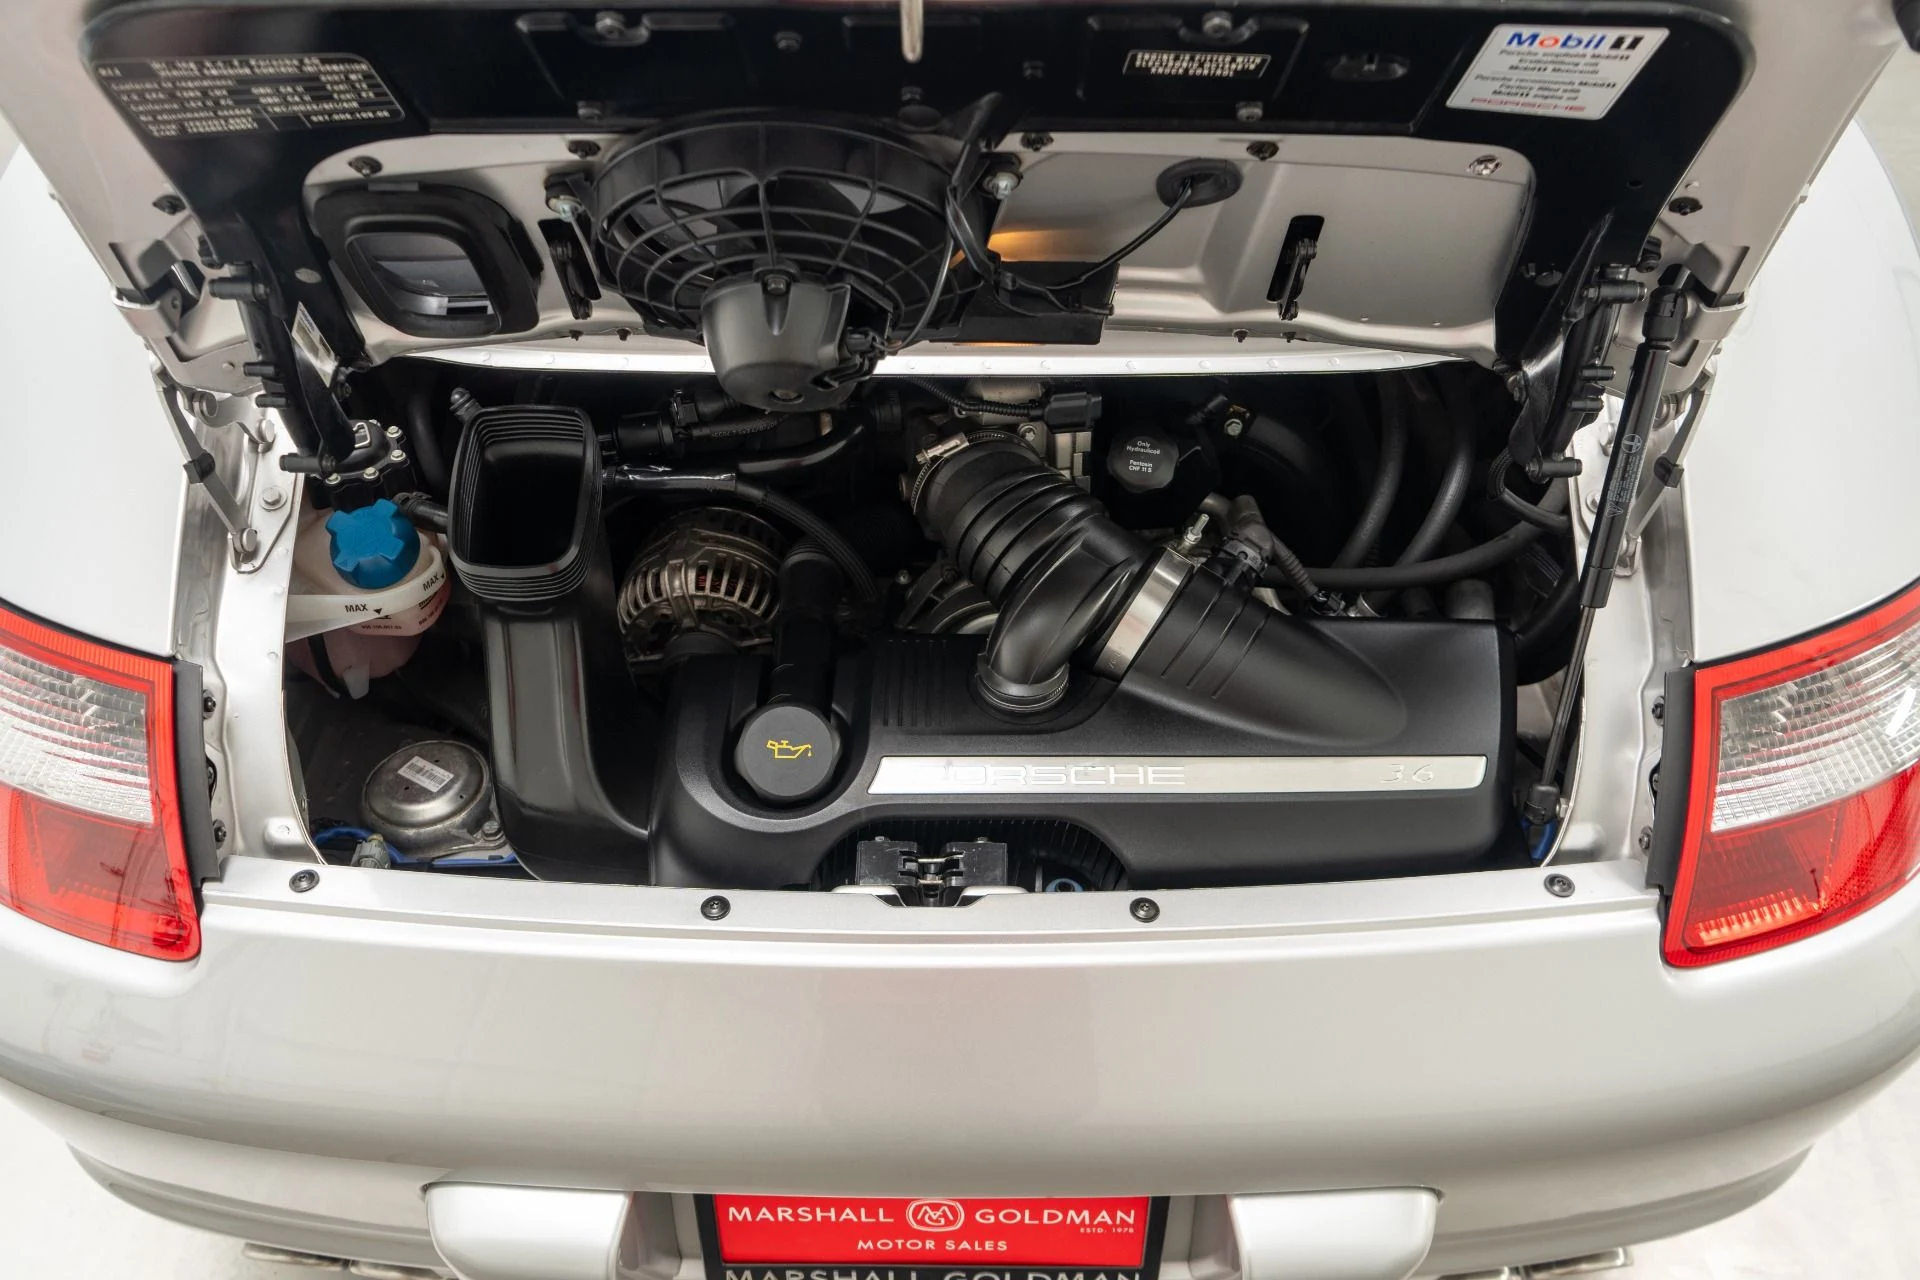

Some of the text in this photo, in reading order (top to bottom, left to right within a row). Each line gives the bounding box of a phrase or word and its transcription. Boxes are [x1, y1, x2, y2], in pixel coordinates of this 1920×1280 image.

[1506, 32, 1607, 49] Mobil
[1470, 97, 1586, 111] PORSCHE
[1130, 459, 1153, 467] Pentosin
[423, 572, 440, 591] MAX
[345, 603, 369, 613] MAX
[728, 1206, 894, 1222] MARSHALL
[974, 1208, 1136, 1225] GOLDMAN
[857, 1239, 1008, 1252] MOTOR SALES
